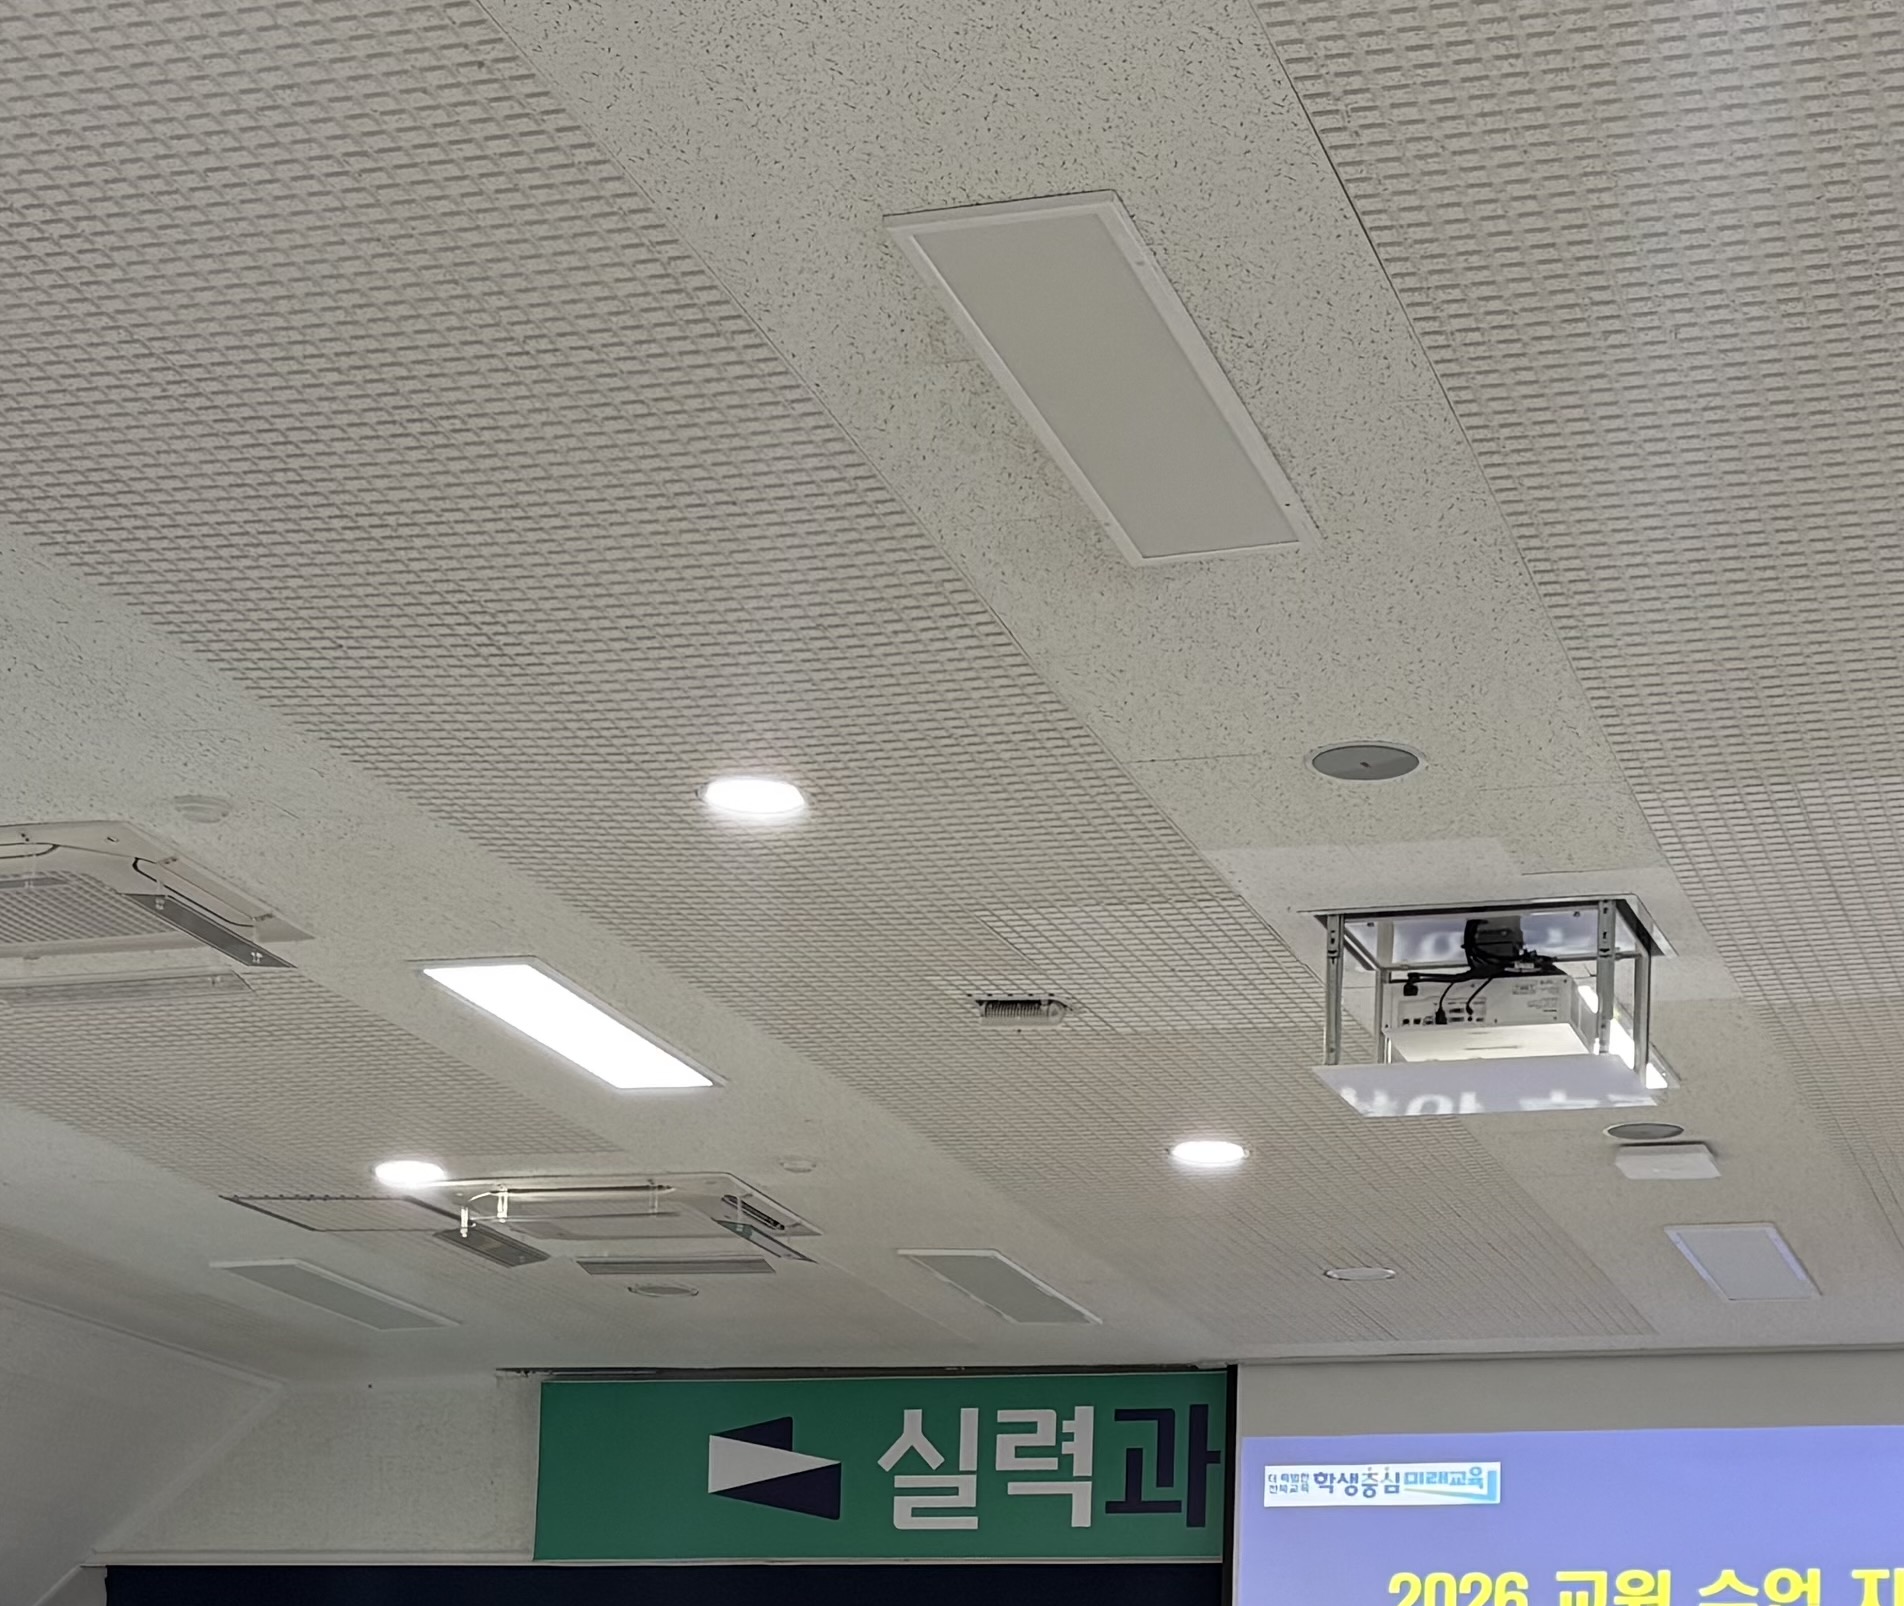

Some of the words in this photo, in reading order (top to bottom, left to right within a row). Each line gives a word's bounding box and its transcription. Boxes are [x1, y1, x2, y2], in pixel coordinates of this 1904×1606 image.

[877, 1402, 1221, 1531] 실력과
[1313, 1466, 1400, 1498] 학생중심
[1403, 1466, 1484, 1489] 미래교육
